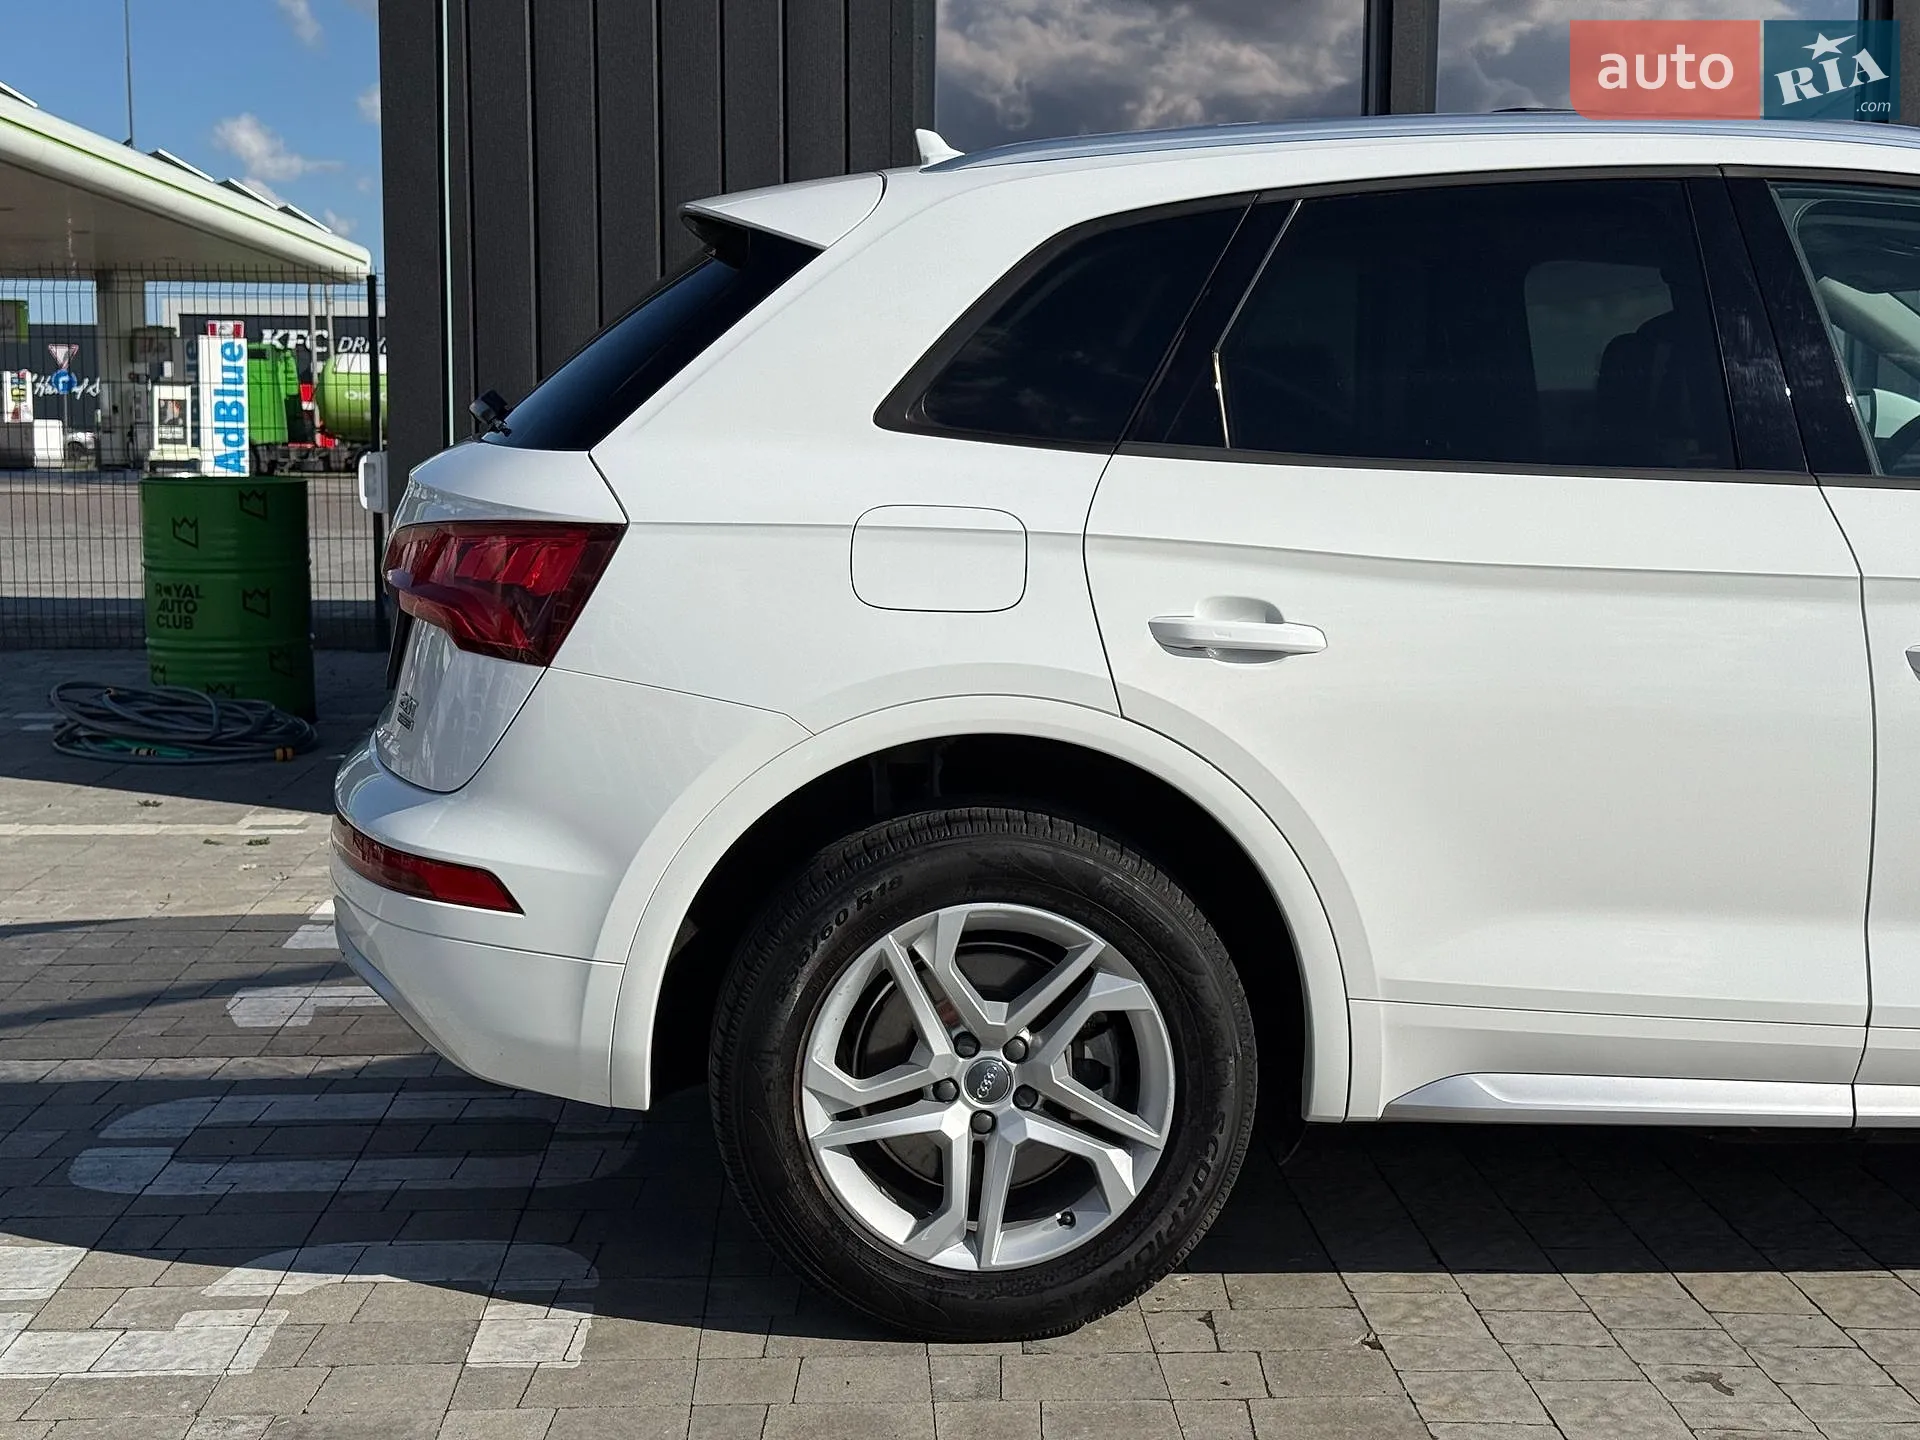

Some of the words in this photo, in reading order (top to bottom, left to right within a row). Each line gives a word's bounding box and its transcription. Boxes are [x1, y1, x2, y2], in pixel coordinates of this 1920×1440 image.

[261, 329, 329, 353] KFC
[213, 340, 246, 474] AdBlue
[156, 598, 198, 614] AUTO
[156, 614, 194, 630] CLUB
